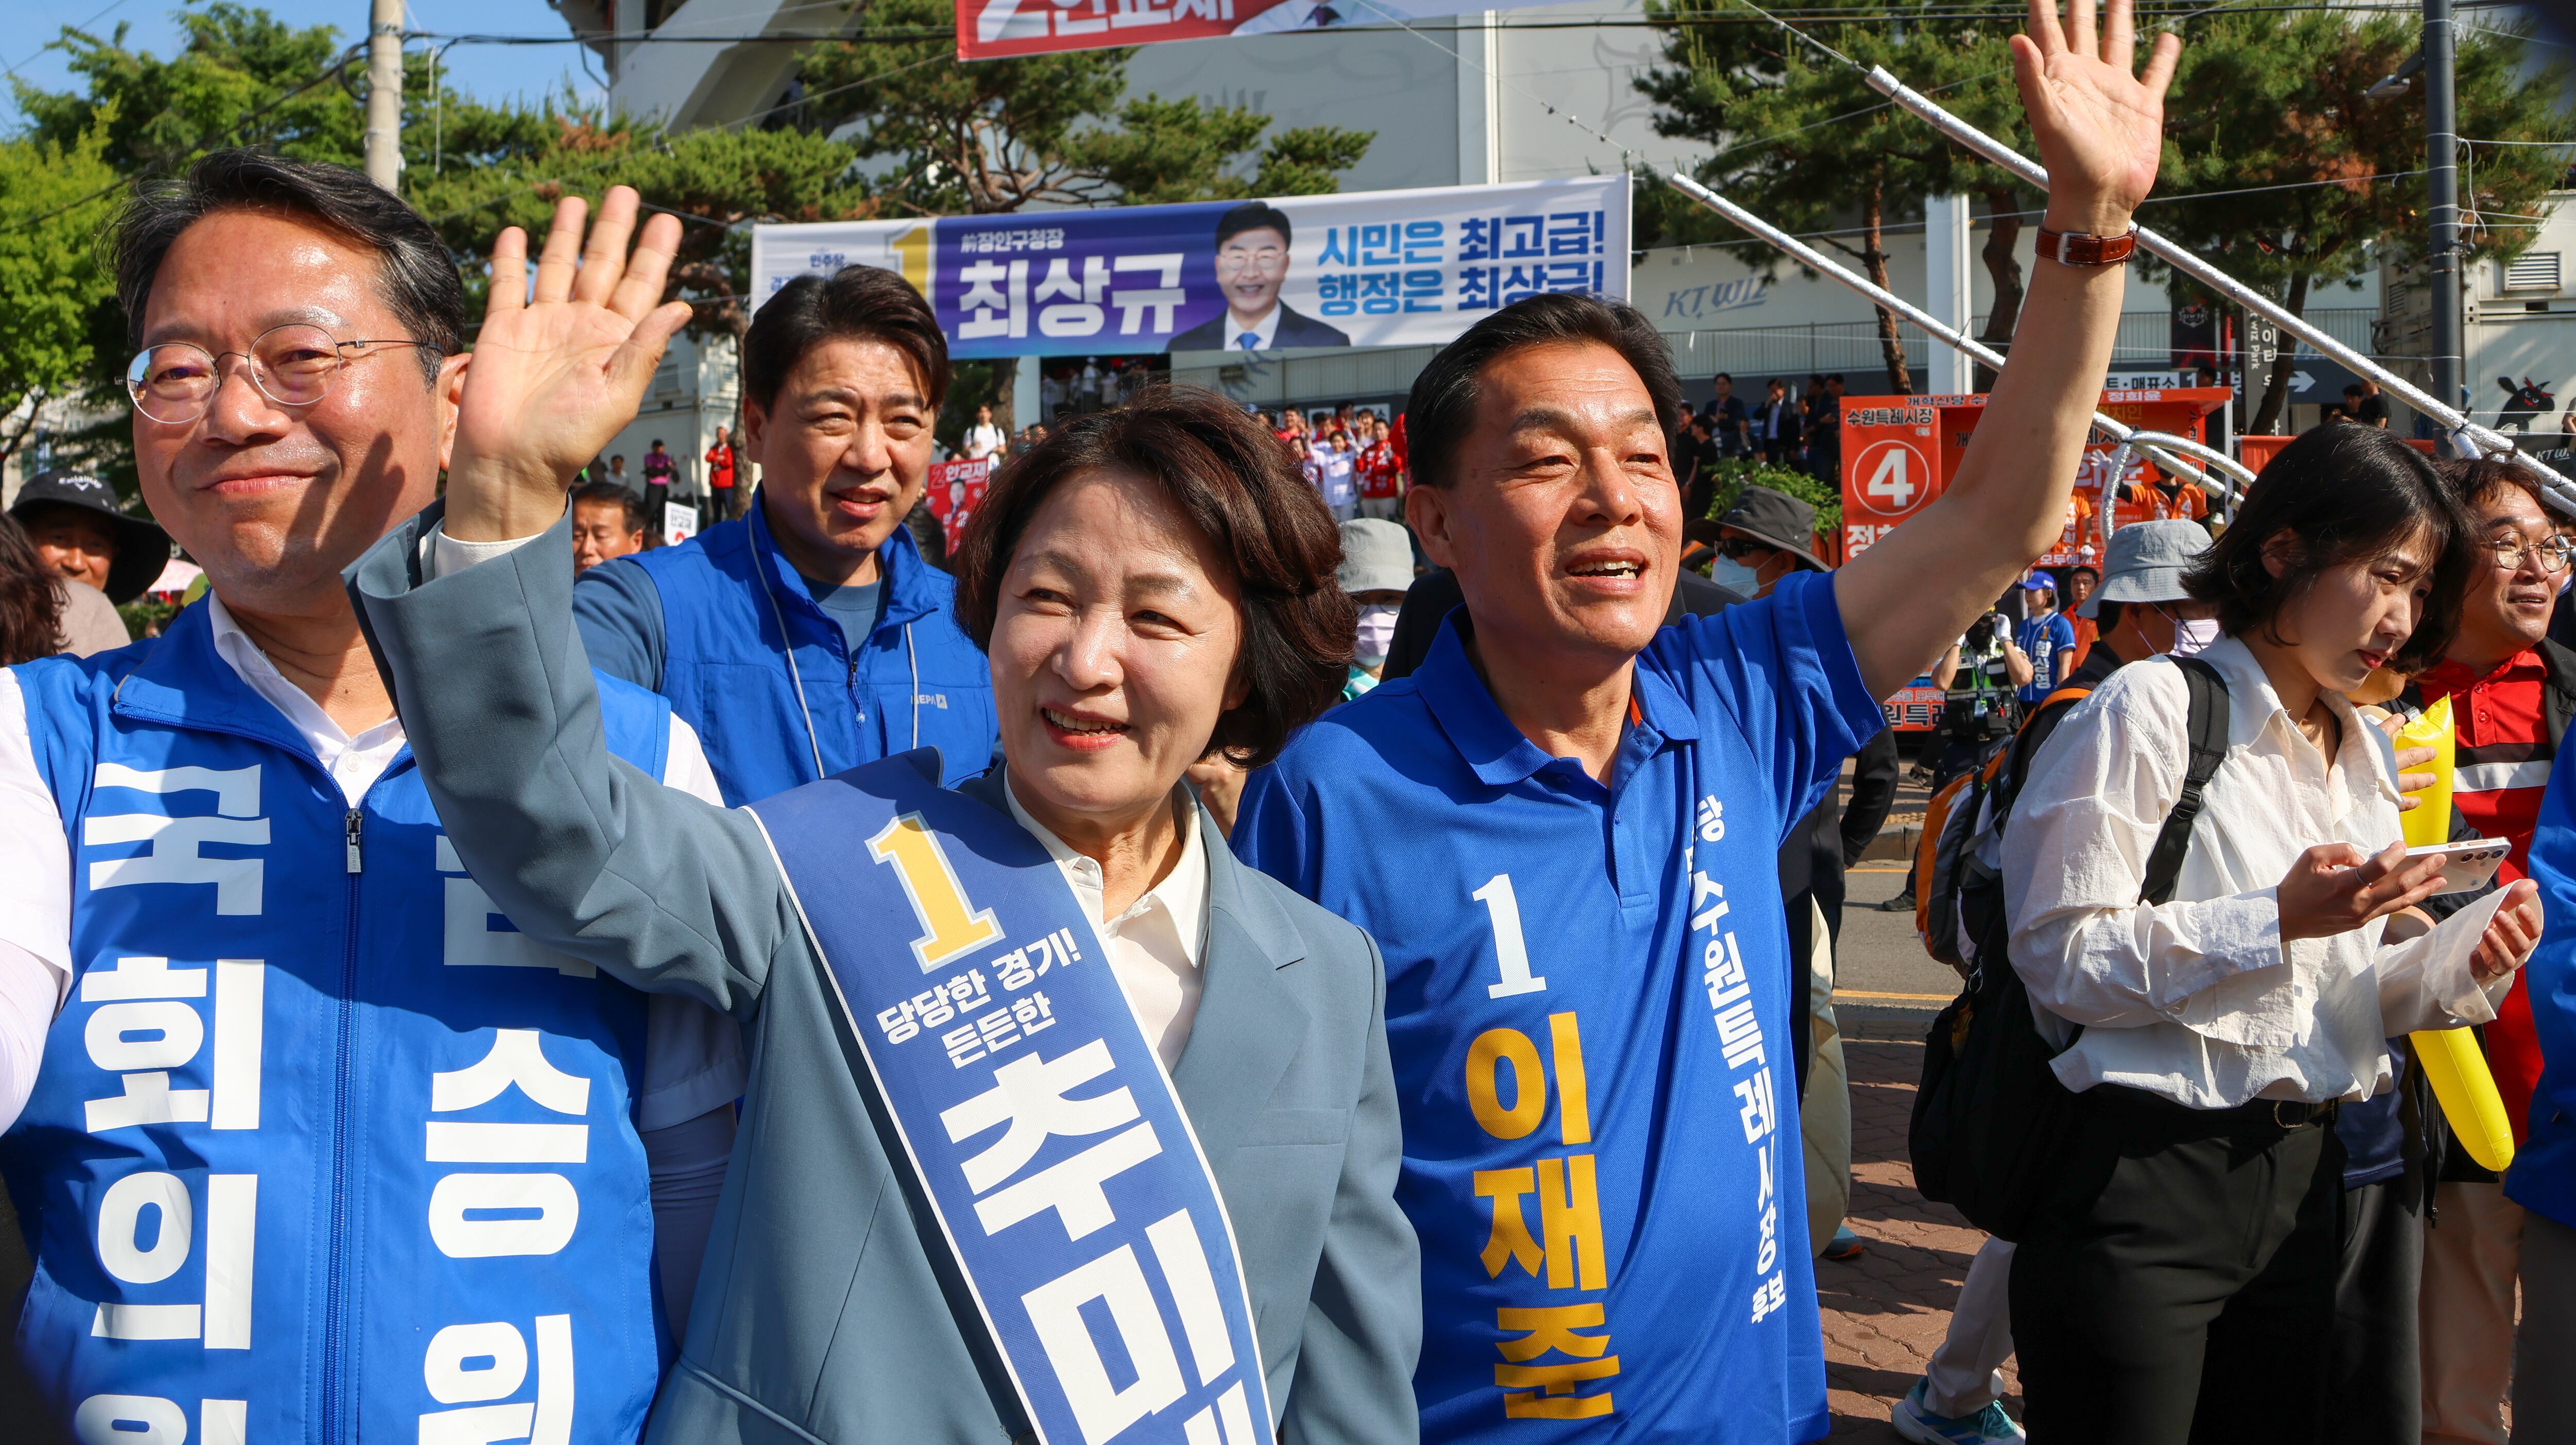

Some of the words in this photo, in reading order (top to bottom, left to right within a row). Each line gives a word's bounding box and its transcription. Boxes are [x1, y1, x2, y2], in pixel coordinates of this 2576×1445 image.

[1317, 220, 1444, 267] 시민은
[1459, 210, 1605, 261] 최고급!
[958, 252, 1187, 340] 최상규
[1317, 268, 1444, 317] 행정은
[1664, 285, 1711, 319] KT
[2251, 344, 2260, 369] Park
[2261, 317, 2278, 362] 이티
[1906, 395, 1965, 407] 개혁신당
[1867, 448, 1914, 506] 4
[2041, 626, 2050, 639] 1
[864, 810, 1006, 975] 1
[1472, 874, 1547, 999] 1
[876, 968, 991, 1045] 당당한
[991, 927, 1082, 992] 경기!
[941, 992, 1056, 1069] 든든한
[1465, 1011, 1621, 1420] 이재준
[1752, 1269, 1786, 1324] 후보
